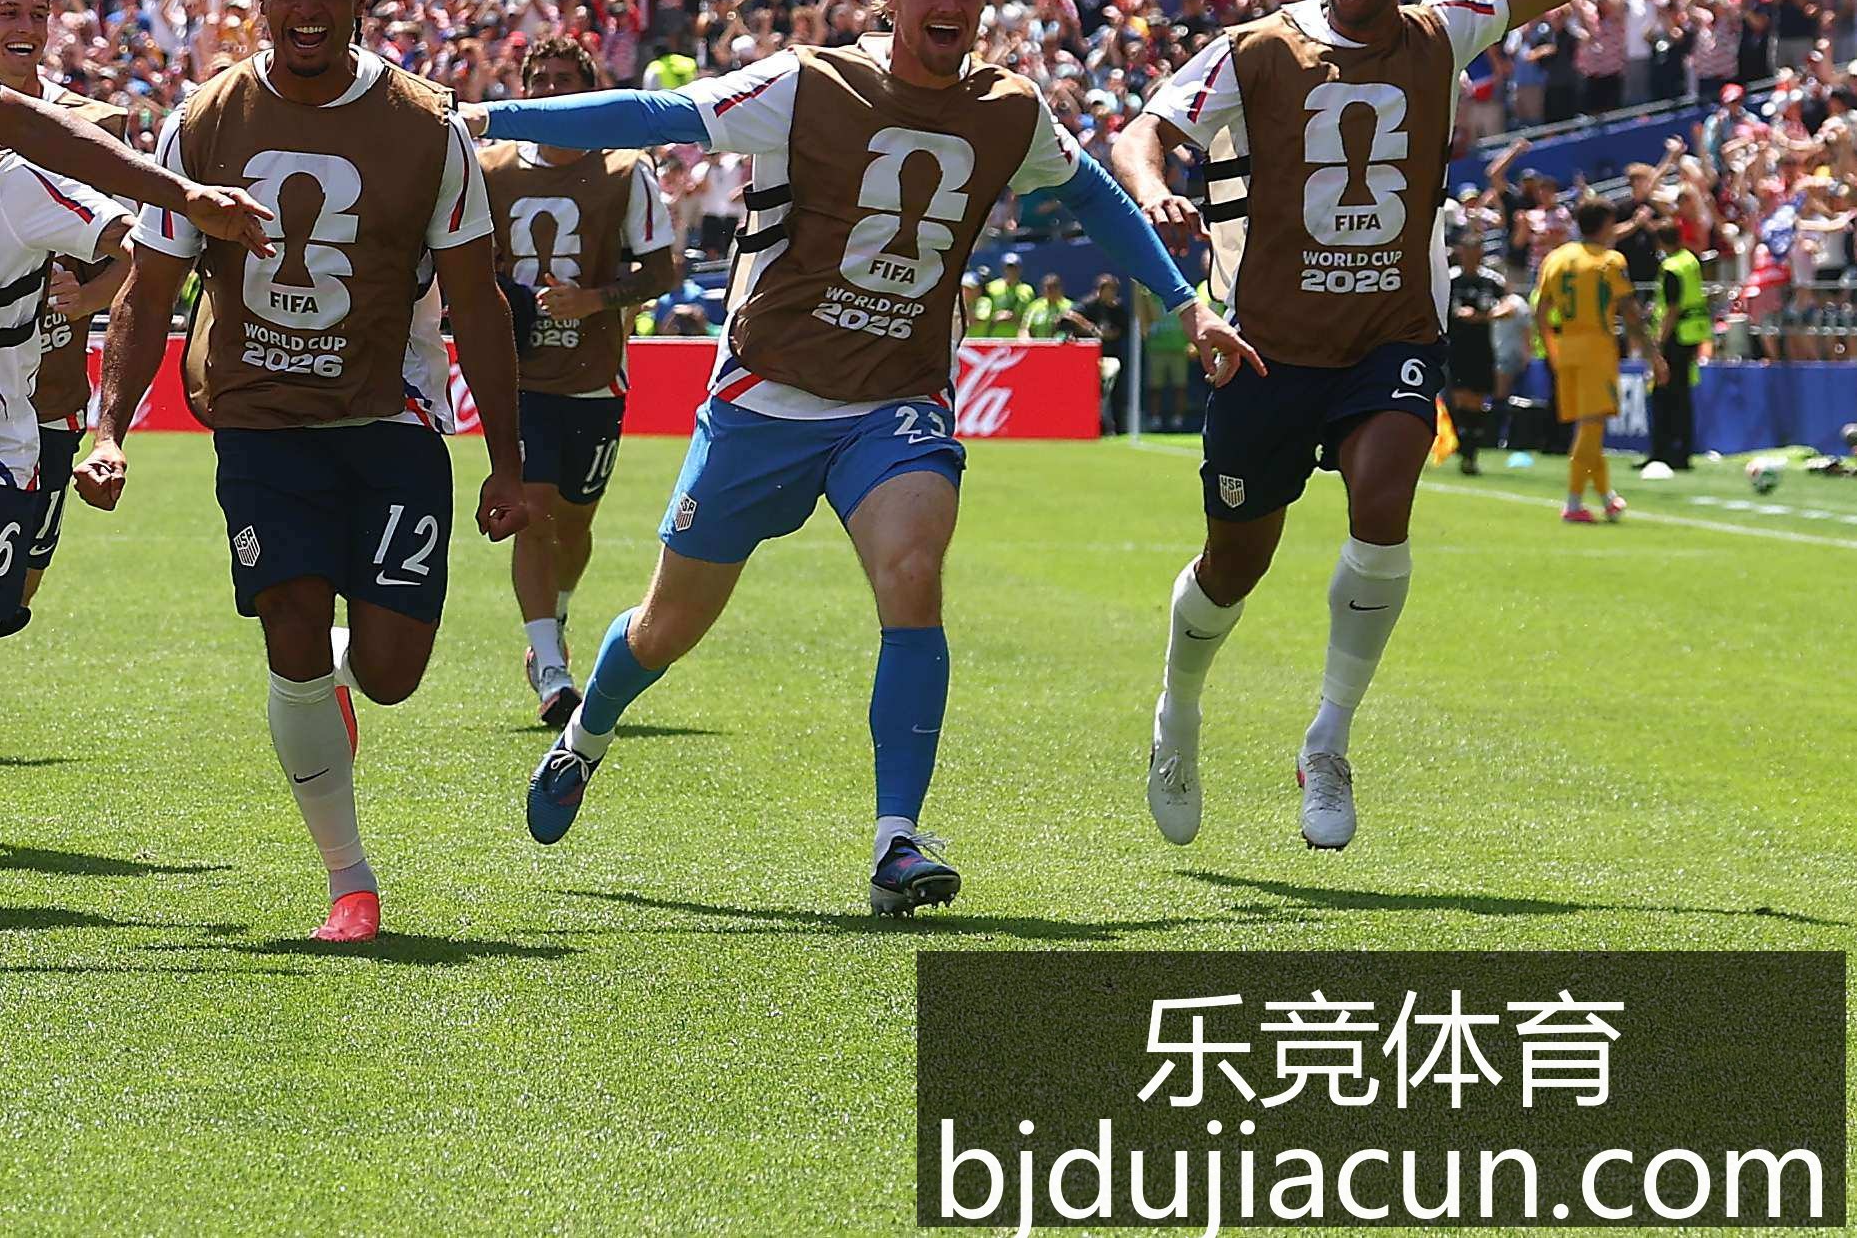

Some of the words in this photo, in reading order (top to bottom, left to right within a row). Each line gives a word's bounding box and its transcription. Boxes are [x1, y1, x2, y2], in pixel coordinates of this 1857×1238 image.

[1334, 214, 1382, 232] FIFA
[1302, 250, 1369, 267] WORLD
[1371, 250, 1402, 266] CUP
[868, 260, 917, 284] FIFA
[1300, 268, 1402, 293] 2026
[269, 290, 319, 314] FIFA
[824, 286, 891, 312] WORLD
[1560, 271, 1578, 320] 5
[811, 302, 913, 340] 2026
[243, 321, 303, 351] WORLD
[307, 335, 347, 352] CUP
[241, 341, 344, 378] 2026
[1401, 358, 1427, 388] 6
[585, 439, 617, 483] 10
[1222, 476, 1242, 490] USA
[235, 526, 255, 548] USA
[373, 504, 438, 576] 12
